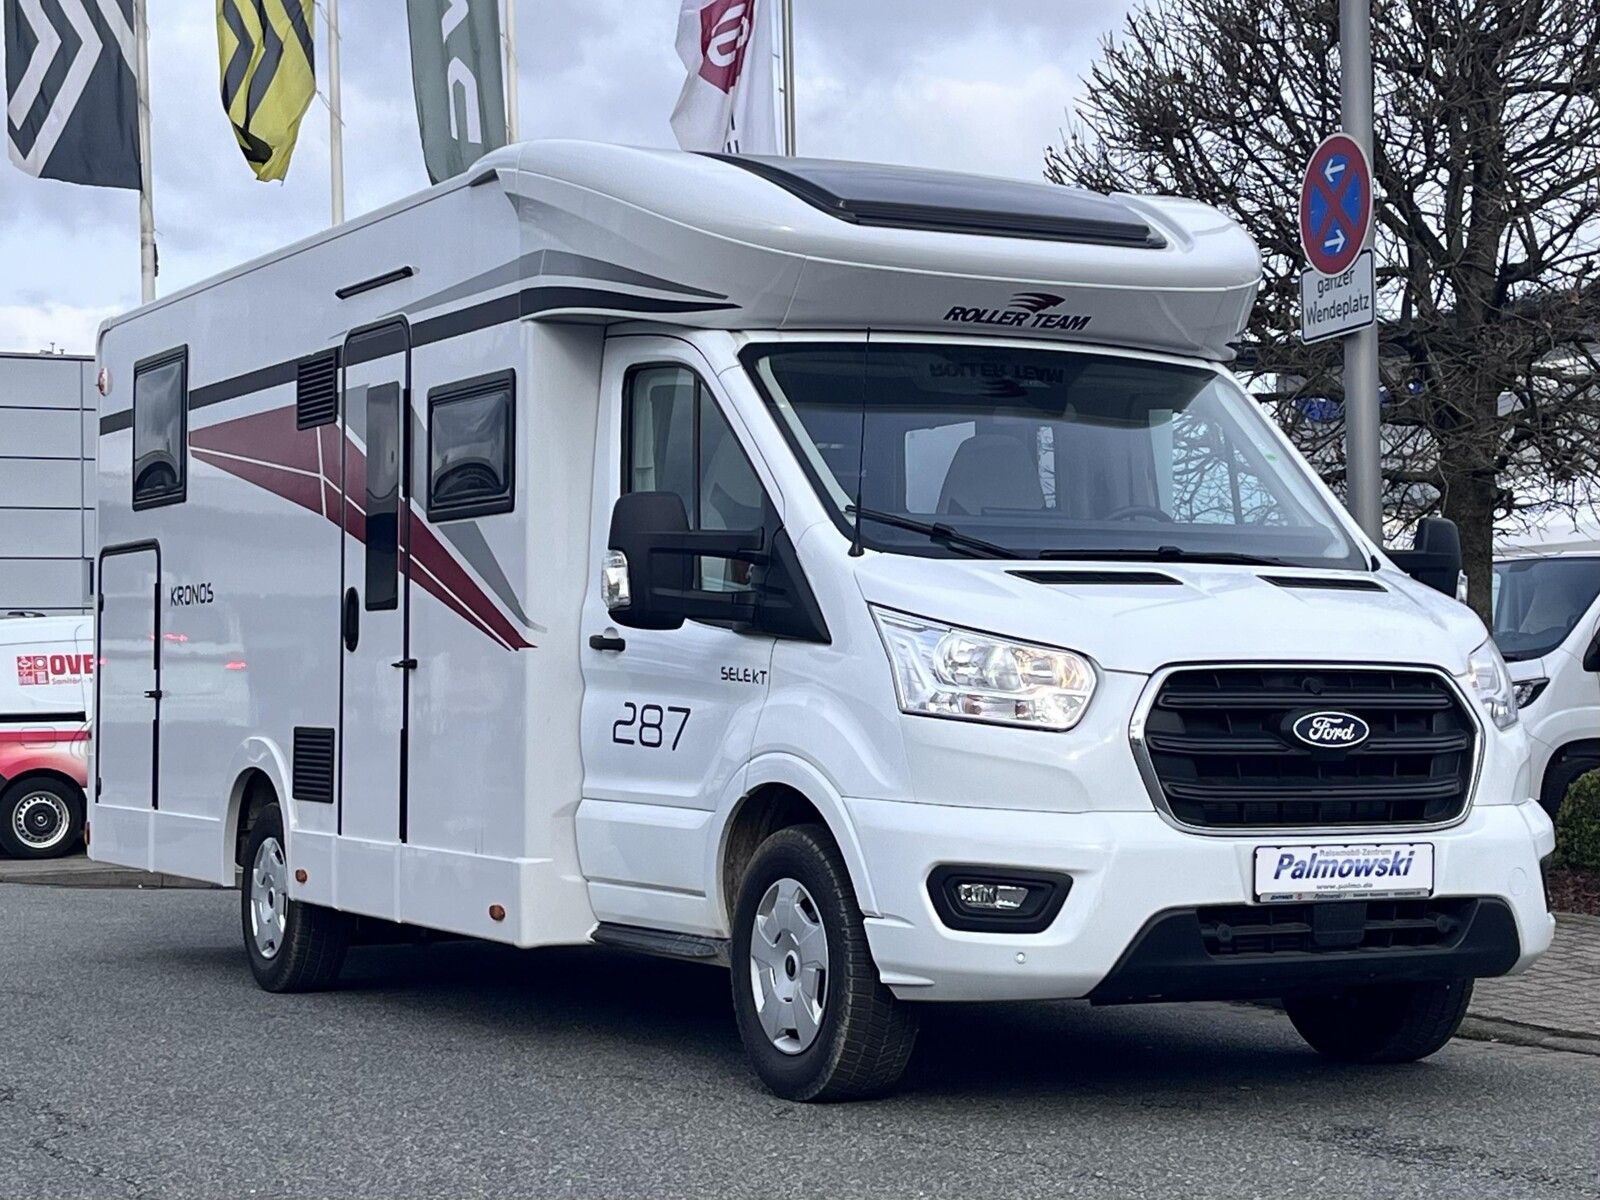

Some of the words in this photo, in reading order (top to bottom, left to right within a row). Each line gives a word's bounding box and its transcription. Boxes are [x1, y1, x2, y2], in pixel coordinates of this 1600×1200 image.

[1317, 270, 1355, 298] ganzer
[943, 306, 1030, 327] ROLLER
[1030, 313, 1092, 330] TEAM
[1306, 294, 1369, 325] Wendeplatz
[170, 582, 214, 606] KRONOS
[720, 666, 767, 685] SELEKT
[612, 701, 691, 751] 287
[1308, 716, 1356, 740] Ford
[1273, 850, 1416, 880] Palmowski
